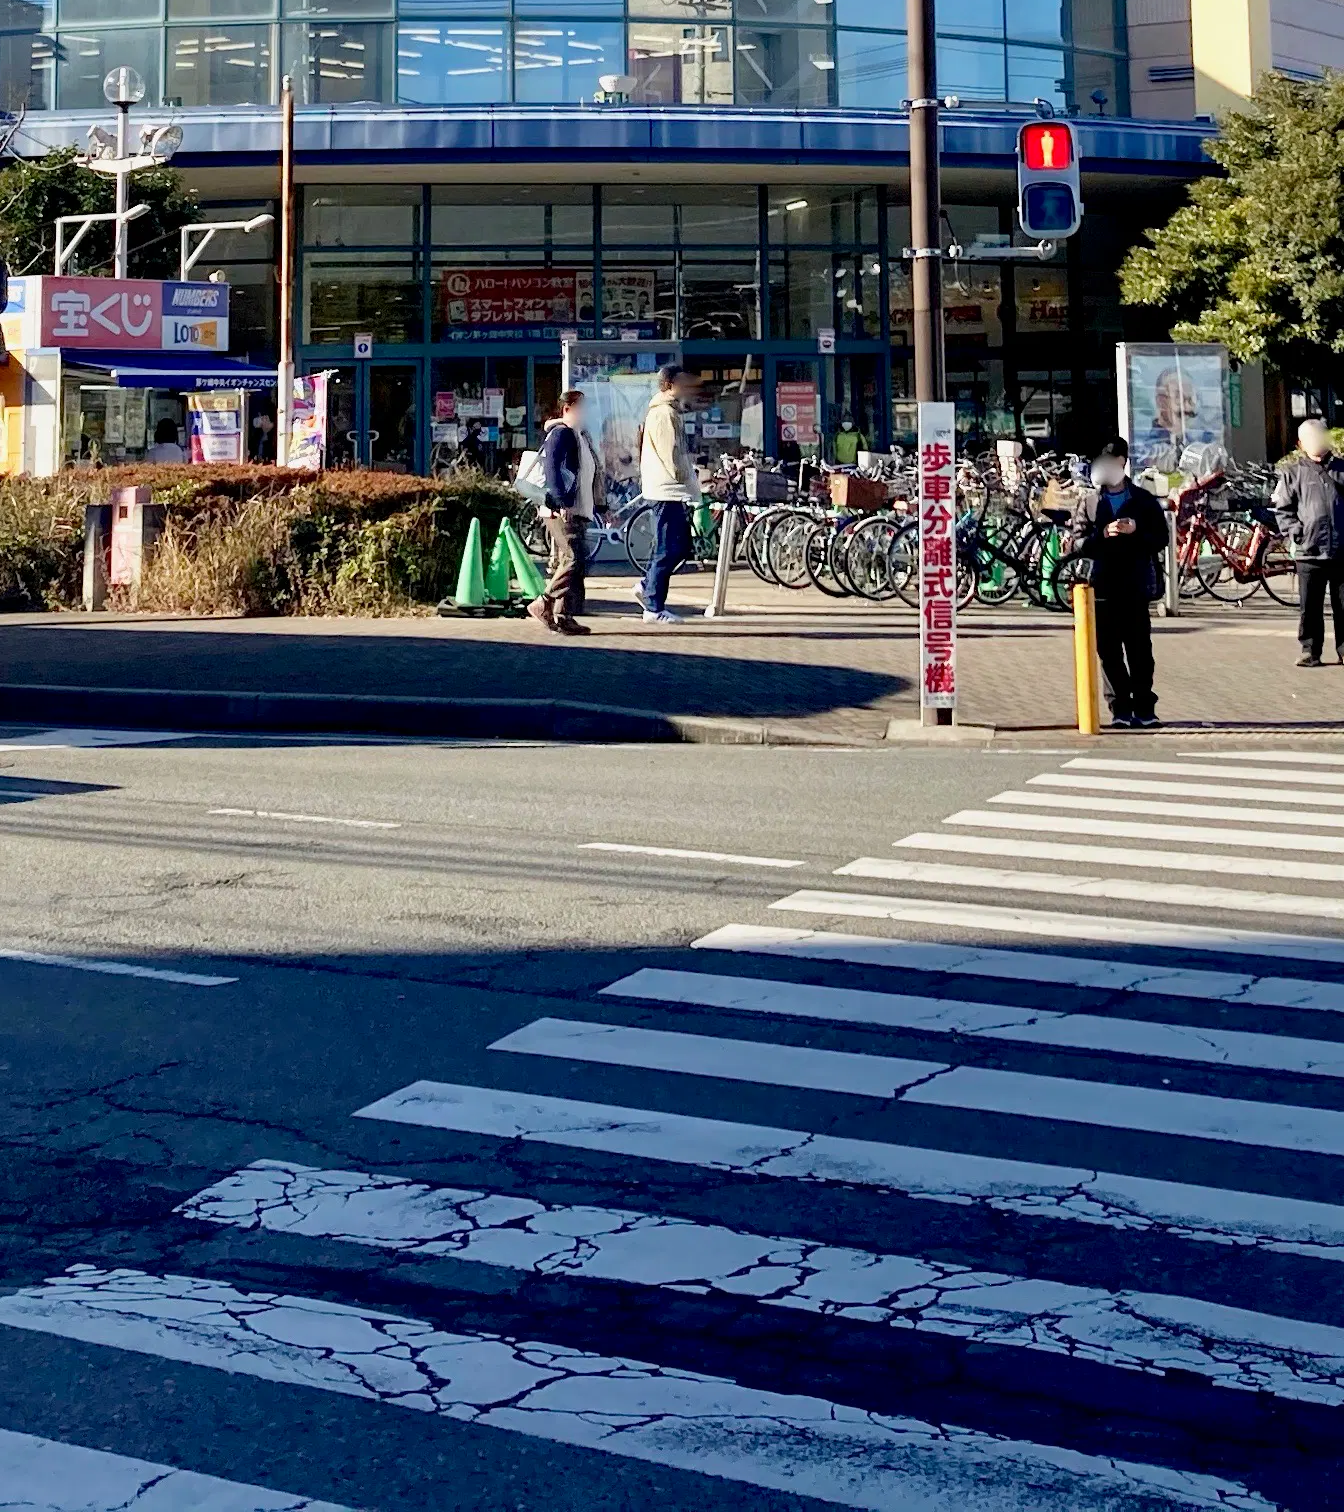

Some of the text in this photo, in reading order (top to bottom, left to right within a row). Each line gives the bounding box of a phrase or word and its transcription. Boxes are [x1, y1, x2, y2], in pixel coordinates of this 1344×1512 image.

[51, 289, 153, 337] 宝くじ
[171, 287, 220, 308] NUMBERS
[921, 442, 955, 694] 歩車分離式信号機
